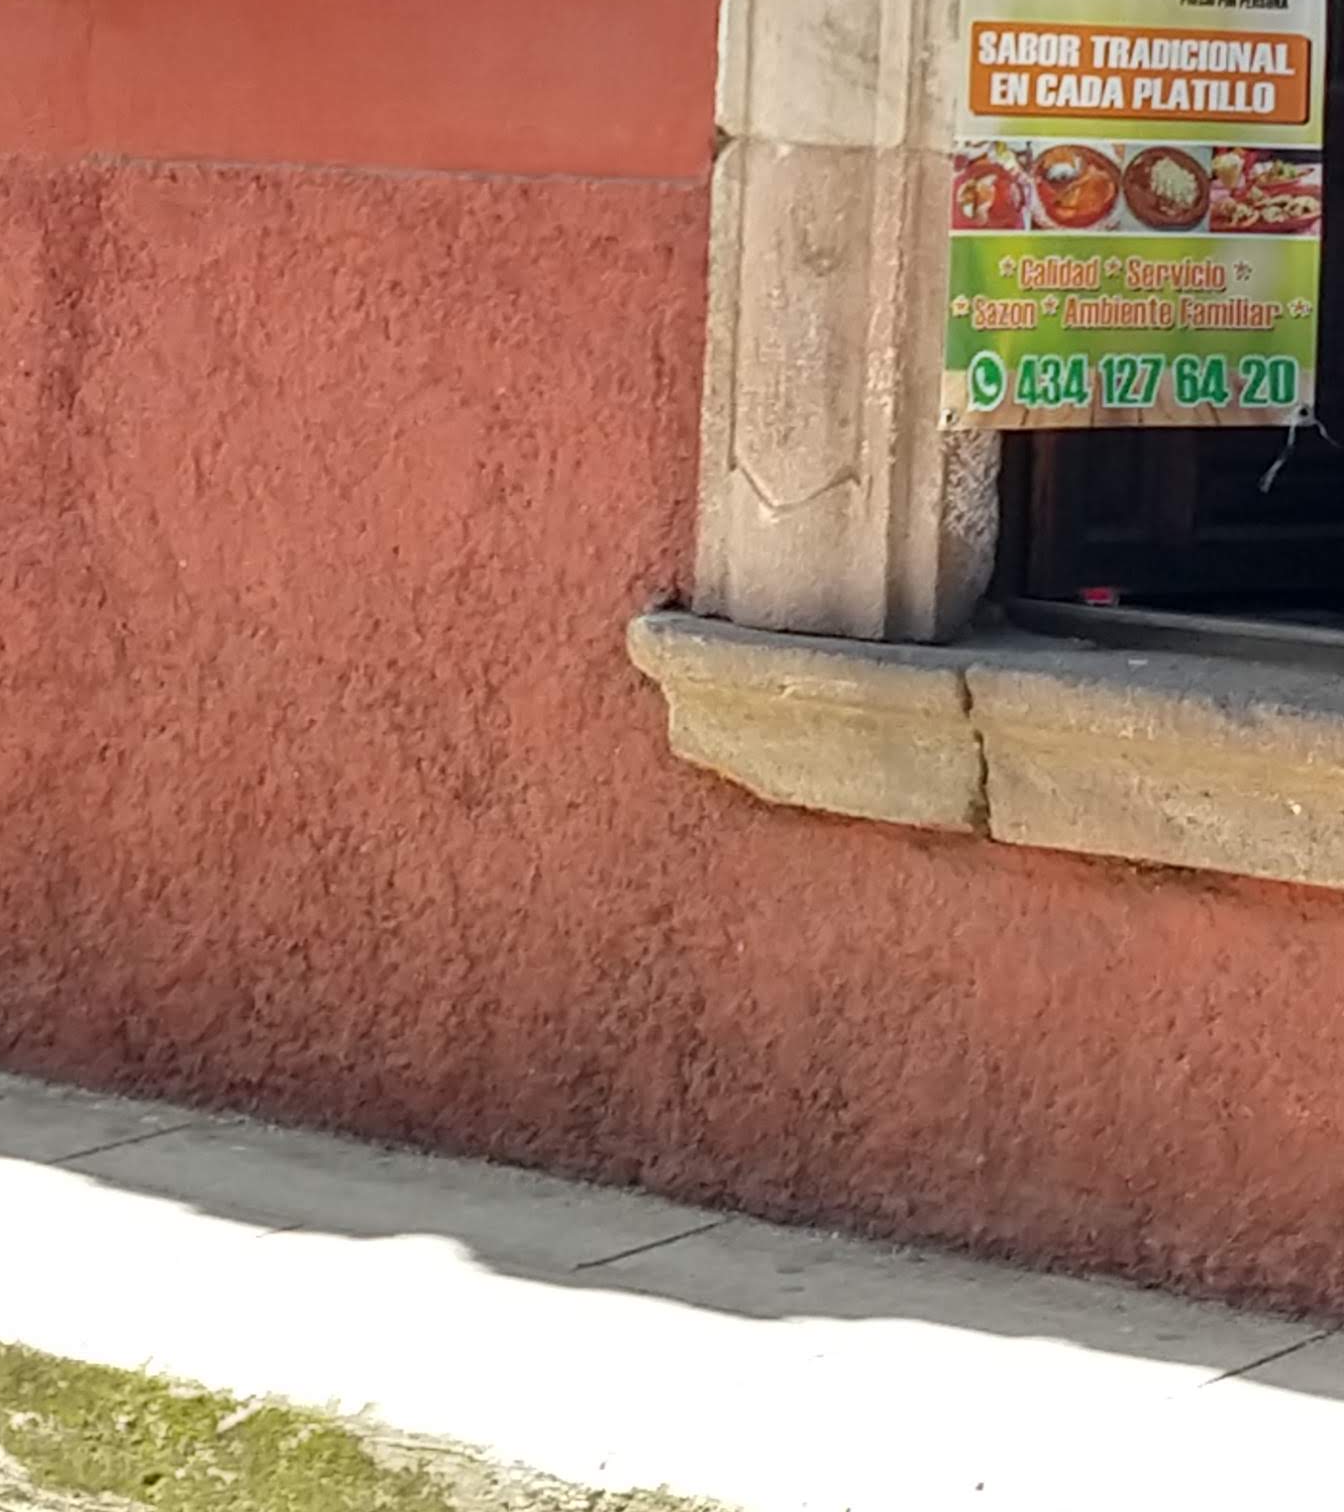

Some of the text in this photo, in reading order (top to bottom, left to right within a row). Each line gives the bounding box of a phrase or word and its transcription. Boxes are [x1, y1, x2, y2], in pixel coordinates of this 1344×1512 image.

[978, 30, 1296, 75] SABOR TRADICIONAL
[990, 72, 1276, 114] EN CADA PLATILLO
[1019, 256, 1227, 290] Calidad Servicio
[973, 298, 1281, 329] Sazon Ambiente Familiar
[1015, 352, 1298, 407] 434 127 64 20
